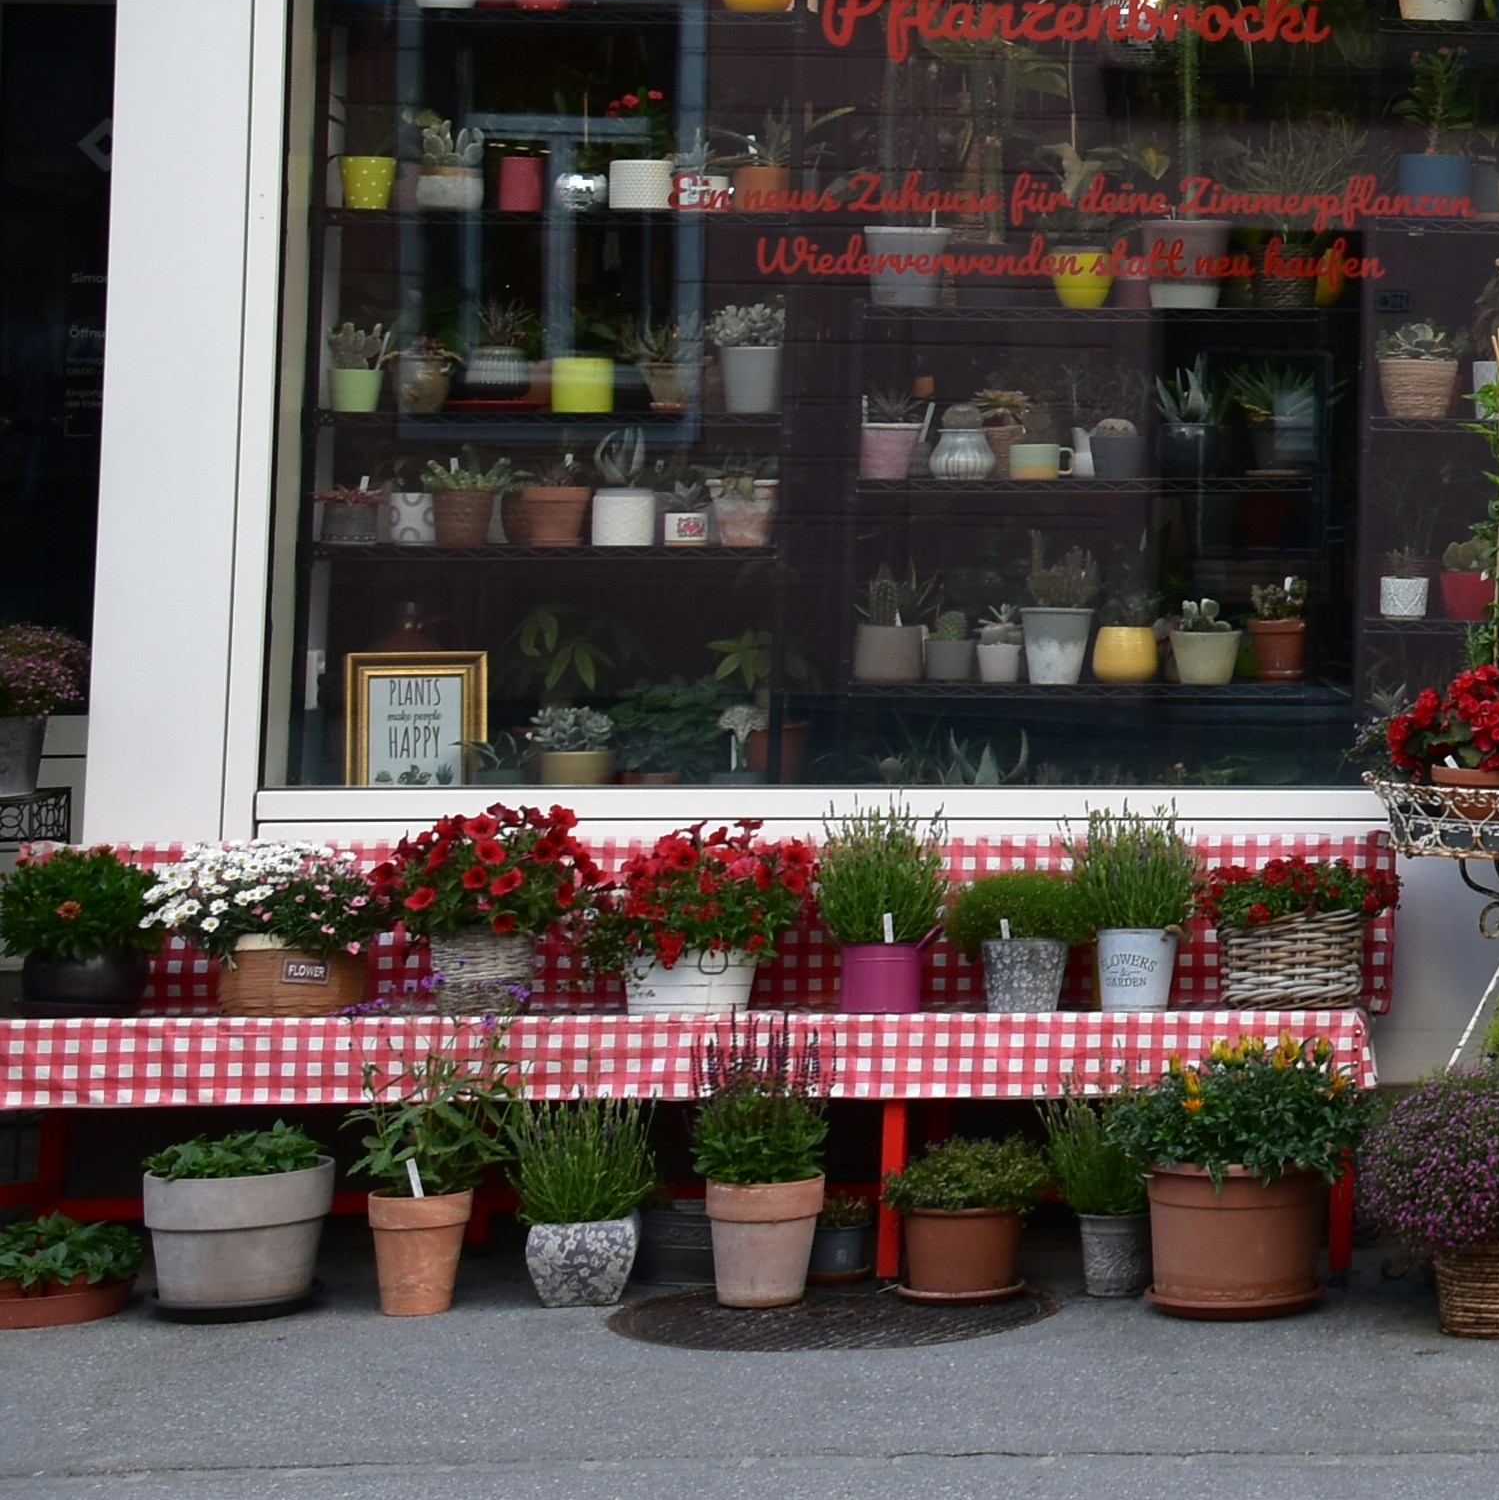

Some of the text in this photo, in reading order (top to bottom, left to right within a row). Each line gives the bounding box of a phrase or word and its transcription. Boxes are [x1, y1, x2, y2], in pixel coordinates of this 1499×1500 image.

[668, 170, 1478, 234] Ein neues Zuhause für deine Zimmerpflanzen
[756, 236, 1387, 293] Wiederverwenden statt neu kaufen
[71, 272, 107, 283] Simo
[389, 678, 442, 707] PLANTS
[387, 709, 442, 725] make people
[388, 726, 441, 760] HAPPY
[288, 964, 325, 978] FLOWER
[1100, 953, 1157, 973] FLOWERS
[1105, 977, 1147, 988] GARDEN
